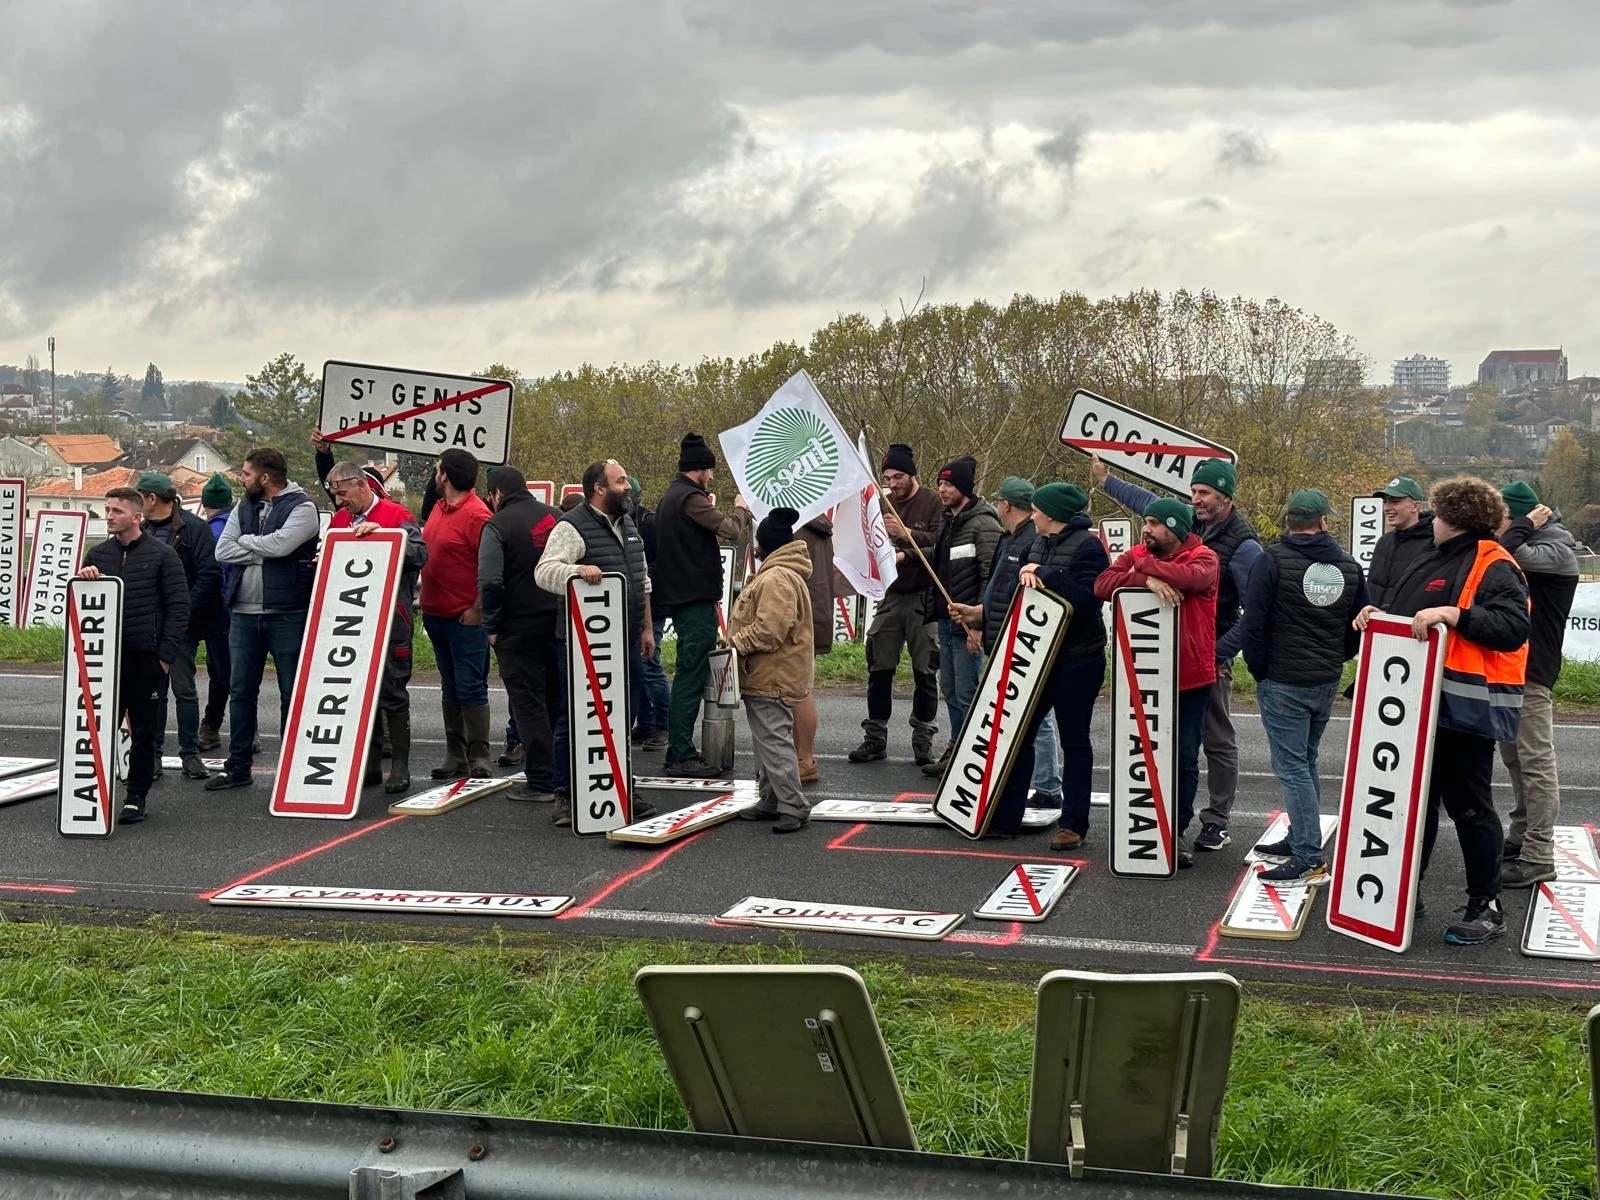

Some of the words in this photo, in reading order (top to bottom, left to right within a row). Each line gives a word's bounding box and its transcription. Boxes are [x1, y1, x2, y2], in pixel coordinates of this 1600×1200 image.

[391, 383, 483, 416] GENIS
[0, 489, 15, 625] MACQUEVILLE
[44, 520, 54, 534] LE
[1359, 504, 1377, 577] GNAC
[32, 542, 55, 626] CHÂTEAU
[50, 532, 74, 616] NEUVICQ
[303, 557, 374, 787] MÉRIGNAC
[583, 590, 616, 820] TOURRIERS
[949, 604, 1049, 818] MONTIGNAC
[1128, 607, 1160, 861] VILLEFAGNAN
[1356, 655, 1411, 905] COGNAC
[288, 889, 554, 910] CYBARDEAUX
[749, 903, 937, 929] ROUILLAC
[995, 866, 1059, 911] MAREUIL
